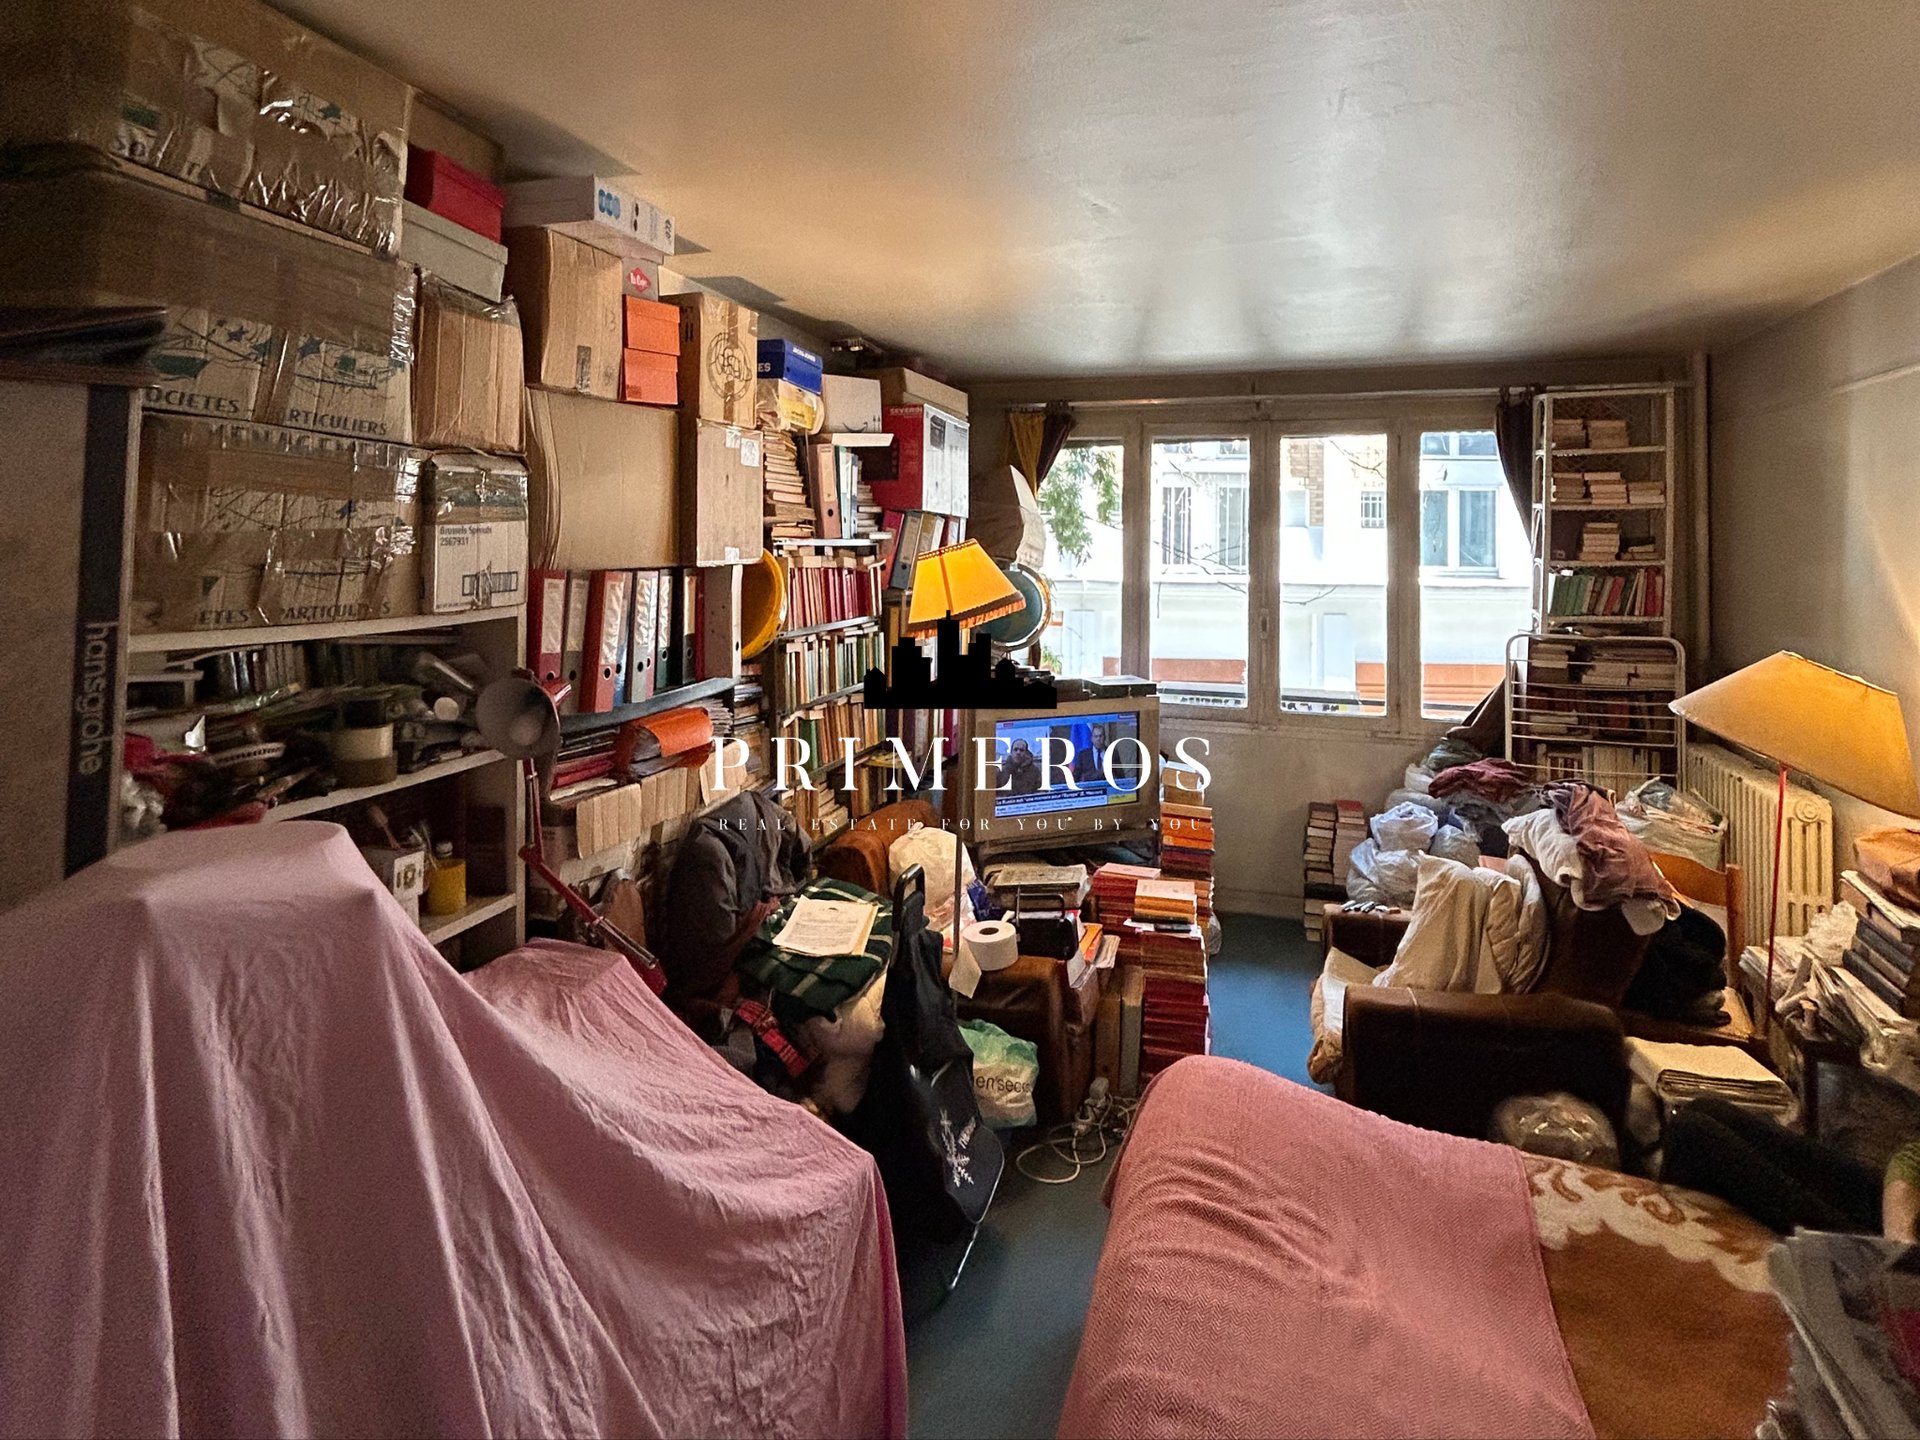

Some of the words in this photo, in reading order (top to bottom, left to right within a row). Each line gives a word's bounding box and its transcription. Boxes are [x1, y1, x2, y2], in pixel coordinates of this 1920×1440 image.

[144, 386, 240, 414] OCIETES
[287, 408, 387, 436] RTICULIERS
[75, 621, 119, 775] hansgrohe
